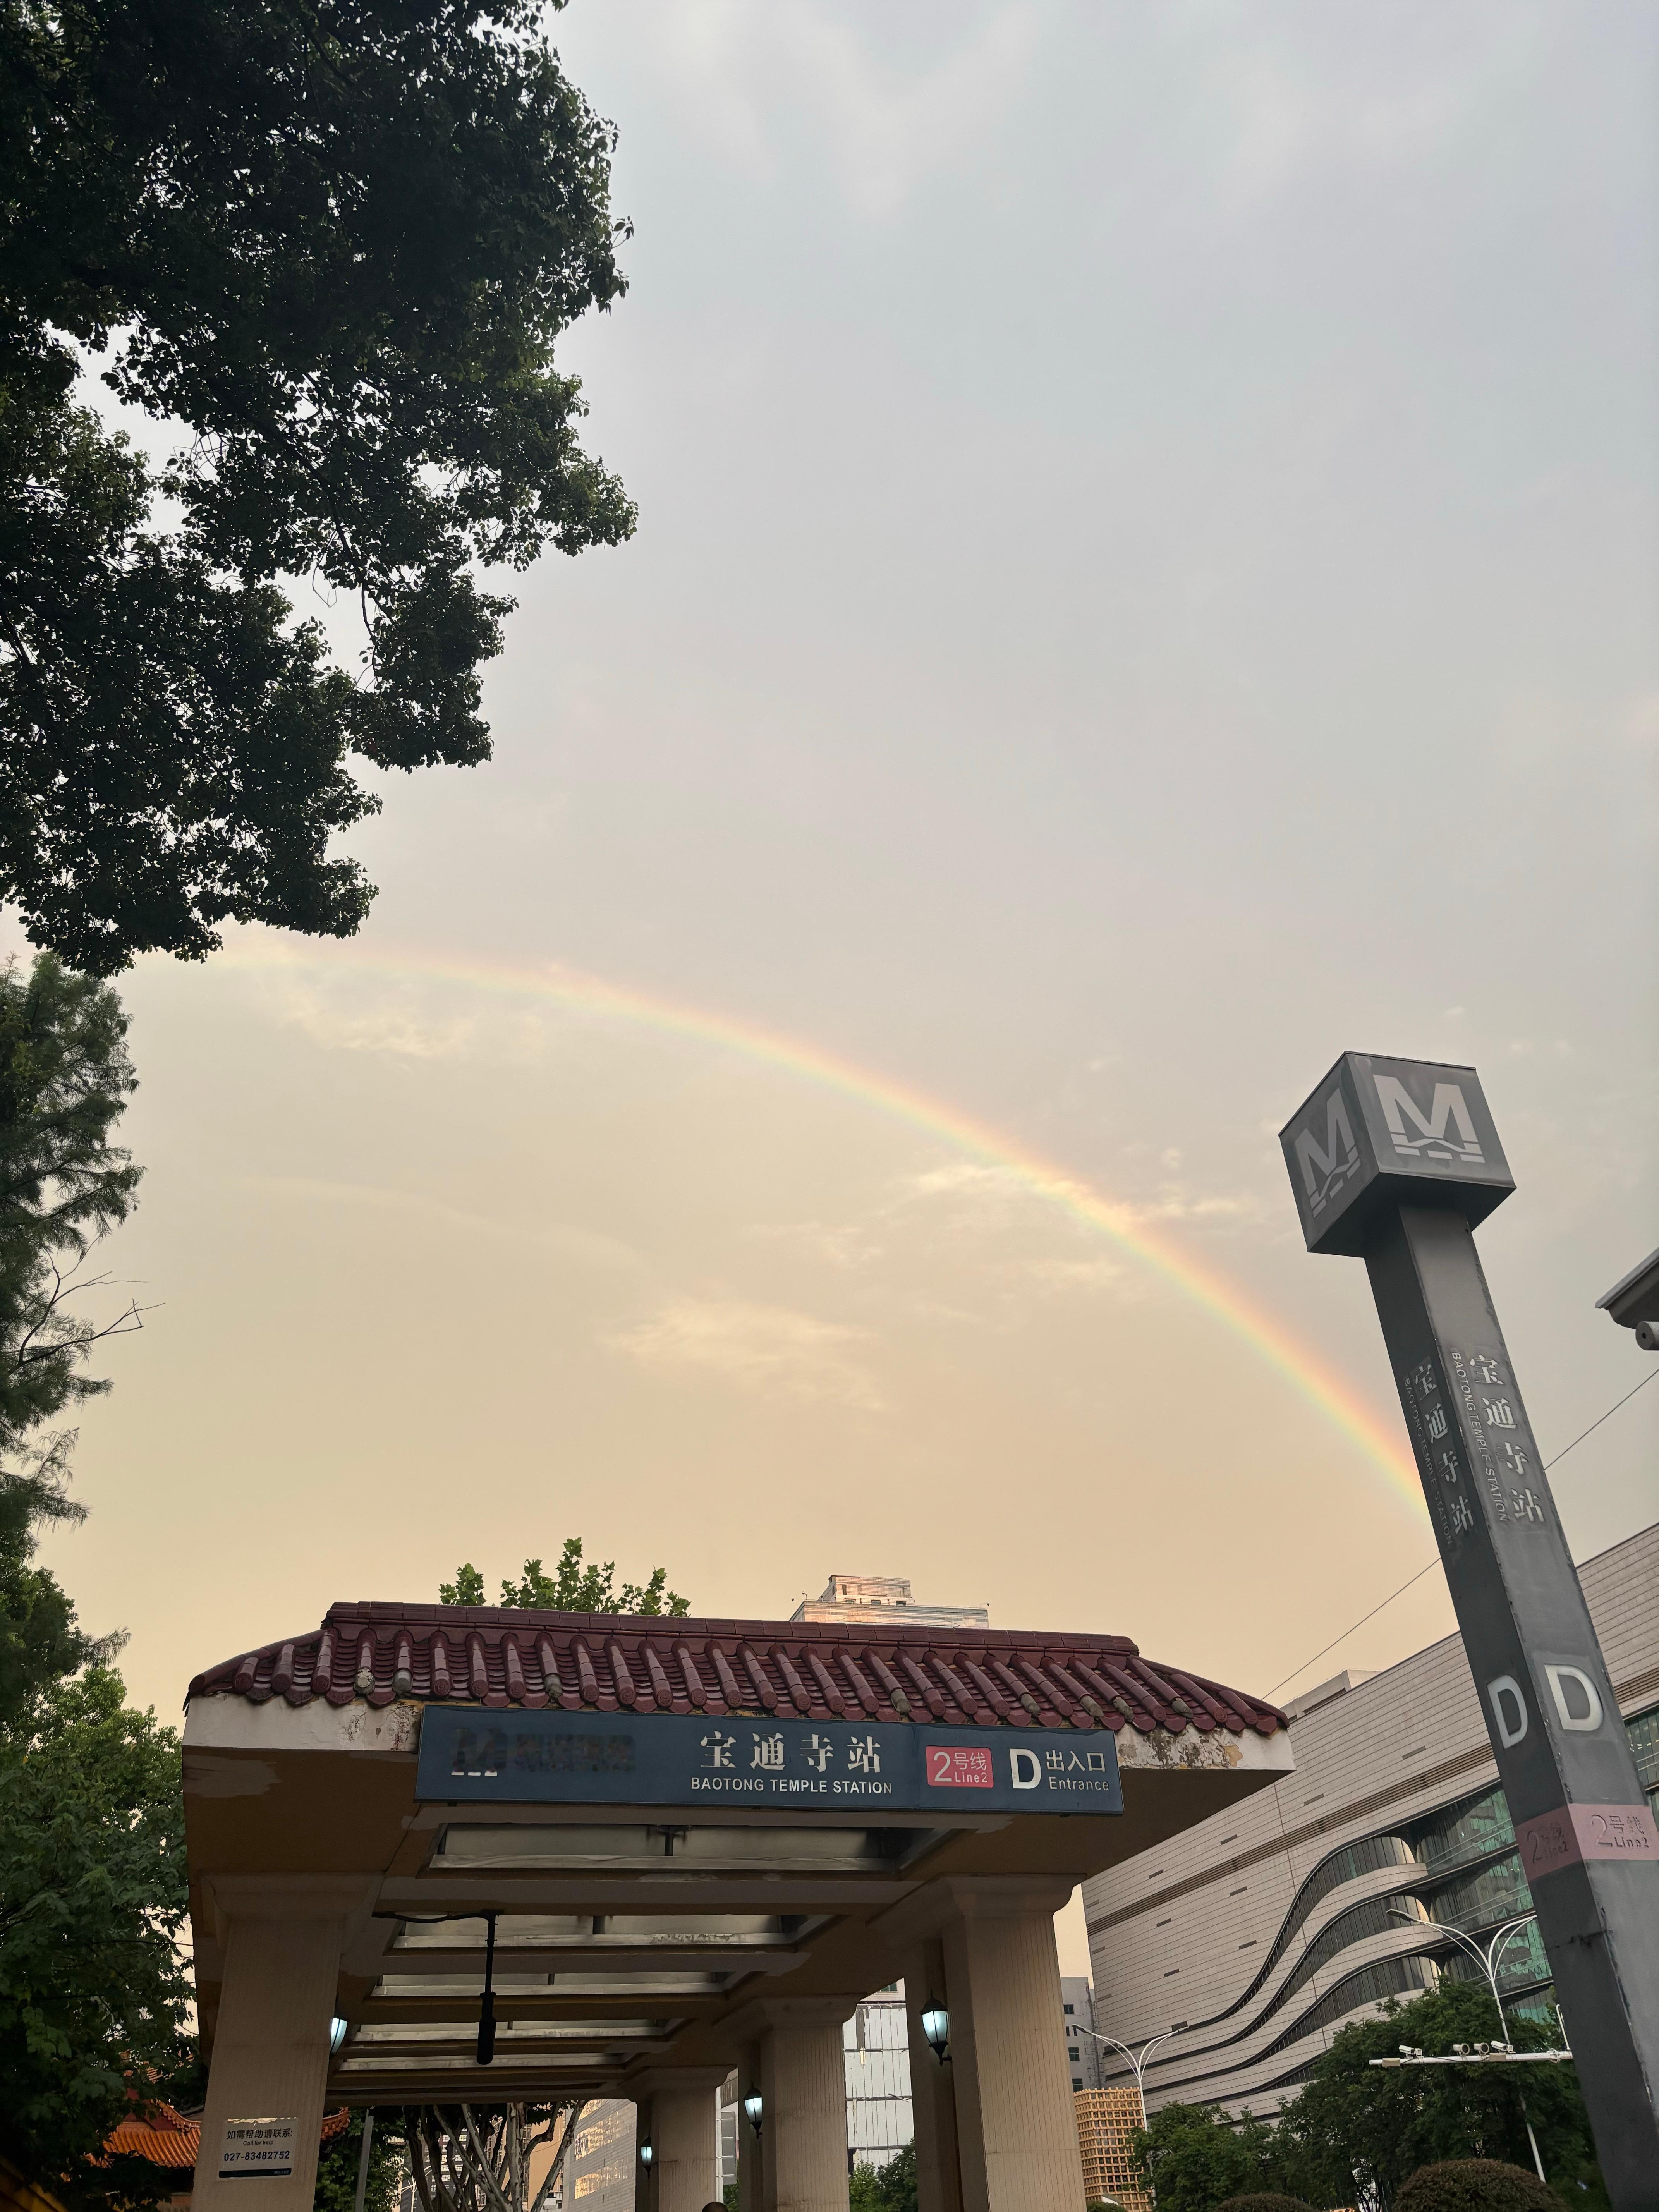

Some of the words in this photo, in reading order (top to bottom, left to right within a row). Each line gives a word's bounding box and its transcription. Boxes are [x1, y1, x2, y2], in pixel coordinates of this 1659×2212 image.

[1415, 1364, 1474, 1534] 宝通寺站
[1452, 1353, 1476, 1411] BAOTONG
[1470, 1412, 1491, 1463] TEMPLE
[1486, 1467, 1510, 1522] STATION
[1470, 1354, 1544, 1522] 宝通寺站
[1434, 1491, 1452, 1544] STATION
[1487, 1675, 1528, 1749] D
[1544, 1664, 1603, 1731] D
[701, 1730, 881, 1773] 宝通寺站
[1009, 1748, 1041, 1789] D
[1046, 1750, 1105, 1772] 出入口
[691, 1777, 764, 1791] BAOTONG
[770, 1779, 828, 1793] TEMPLE
[833, 1781, 892, 1794] STATION
[1049, 1776, 1109, 1791] Entrance
[224, 2150, 290, 2162] 027-83482752
